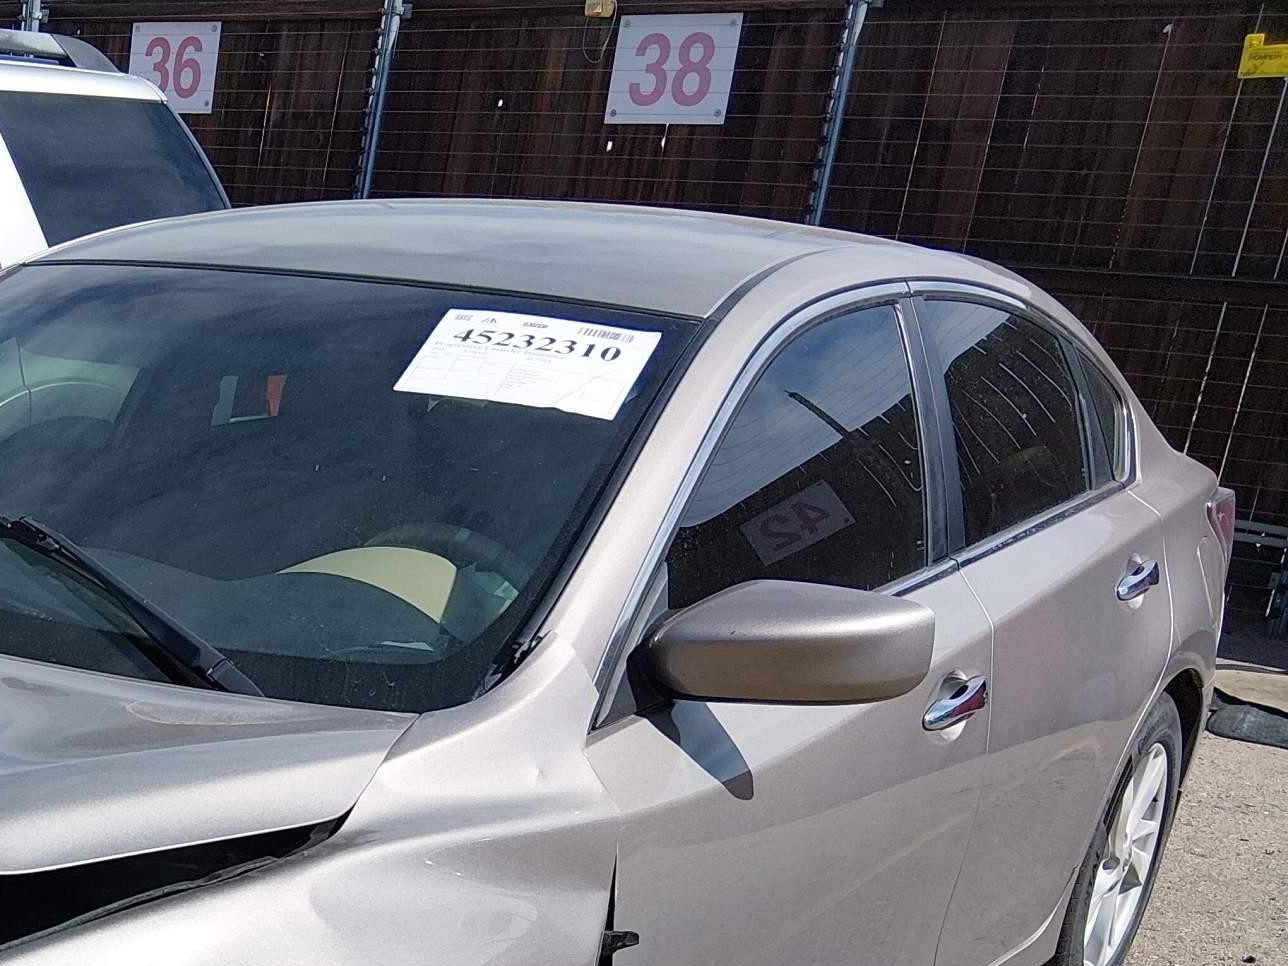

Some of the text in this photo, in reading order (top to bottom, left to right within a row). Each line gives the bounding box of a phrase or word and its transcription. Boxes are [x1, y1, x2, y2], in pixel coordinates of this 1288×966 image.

[145, 35, 203, 99] 36
[629, 31, 716, 107] 38
[453, 328, 622, 362] 45232310
